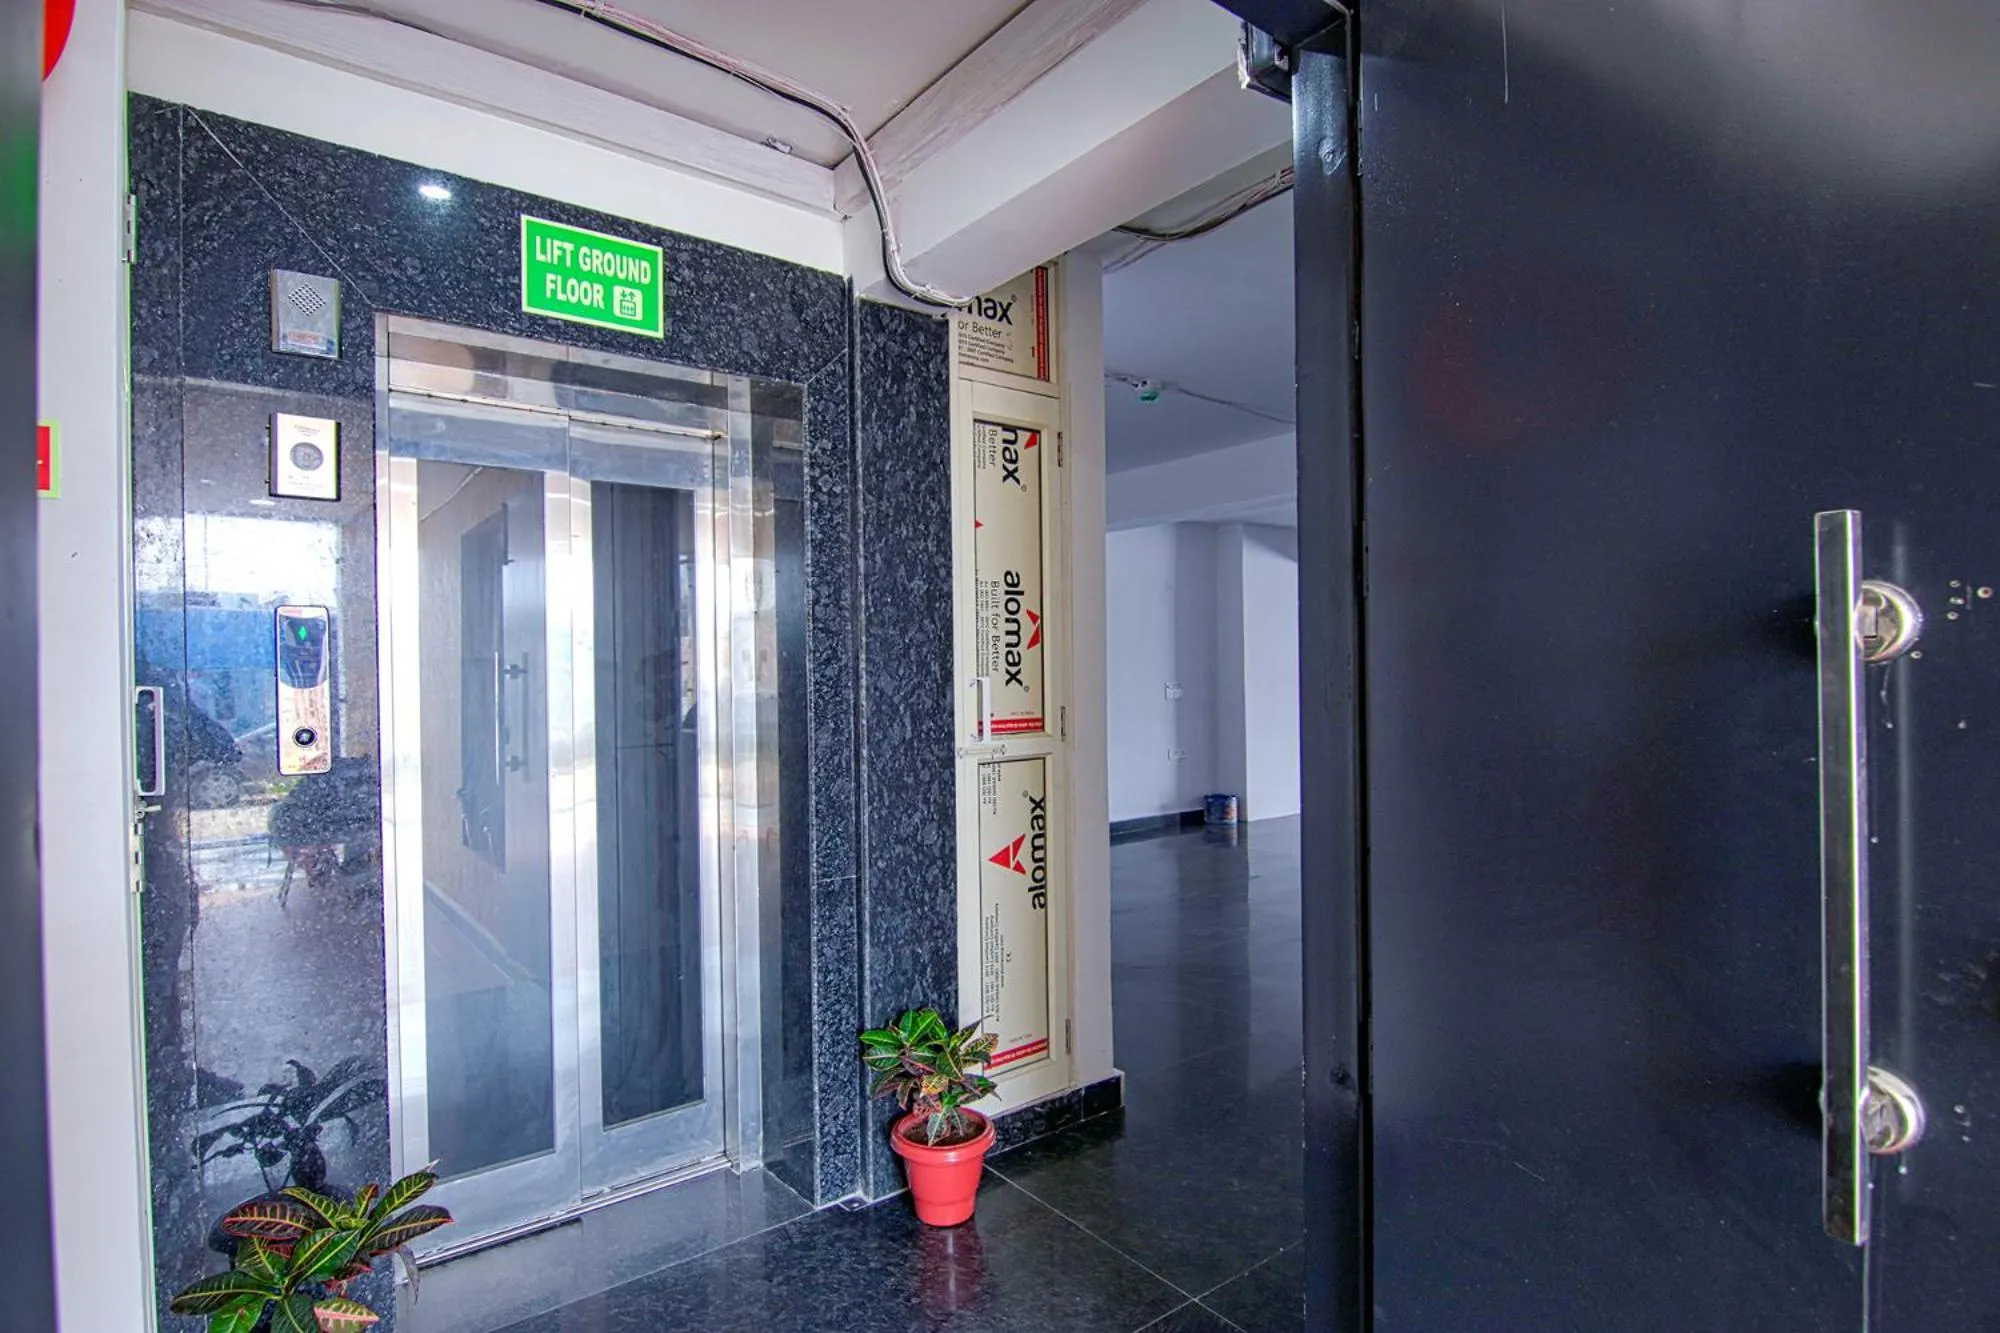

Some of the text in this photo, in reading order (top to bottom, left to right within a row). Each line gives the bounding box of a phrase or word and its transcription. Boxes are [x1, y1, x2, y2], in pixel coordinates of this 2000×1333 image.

[535, 235, 651, 284] LIFT GROUND
[545, 273, 605, 310] FLOOR
[971, 321, 1003, 339] Better
[987, 428, 998, 468] Better
[990, 580, 1001, 673] Built for Better
[1003, 570, 1024, 687] alomax
[1027, 795, 1047, 910] alomax
